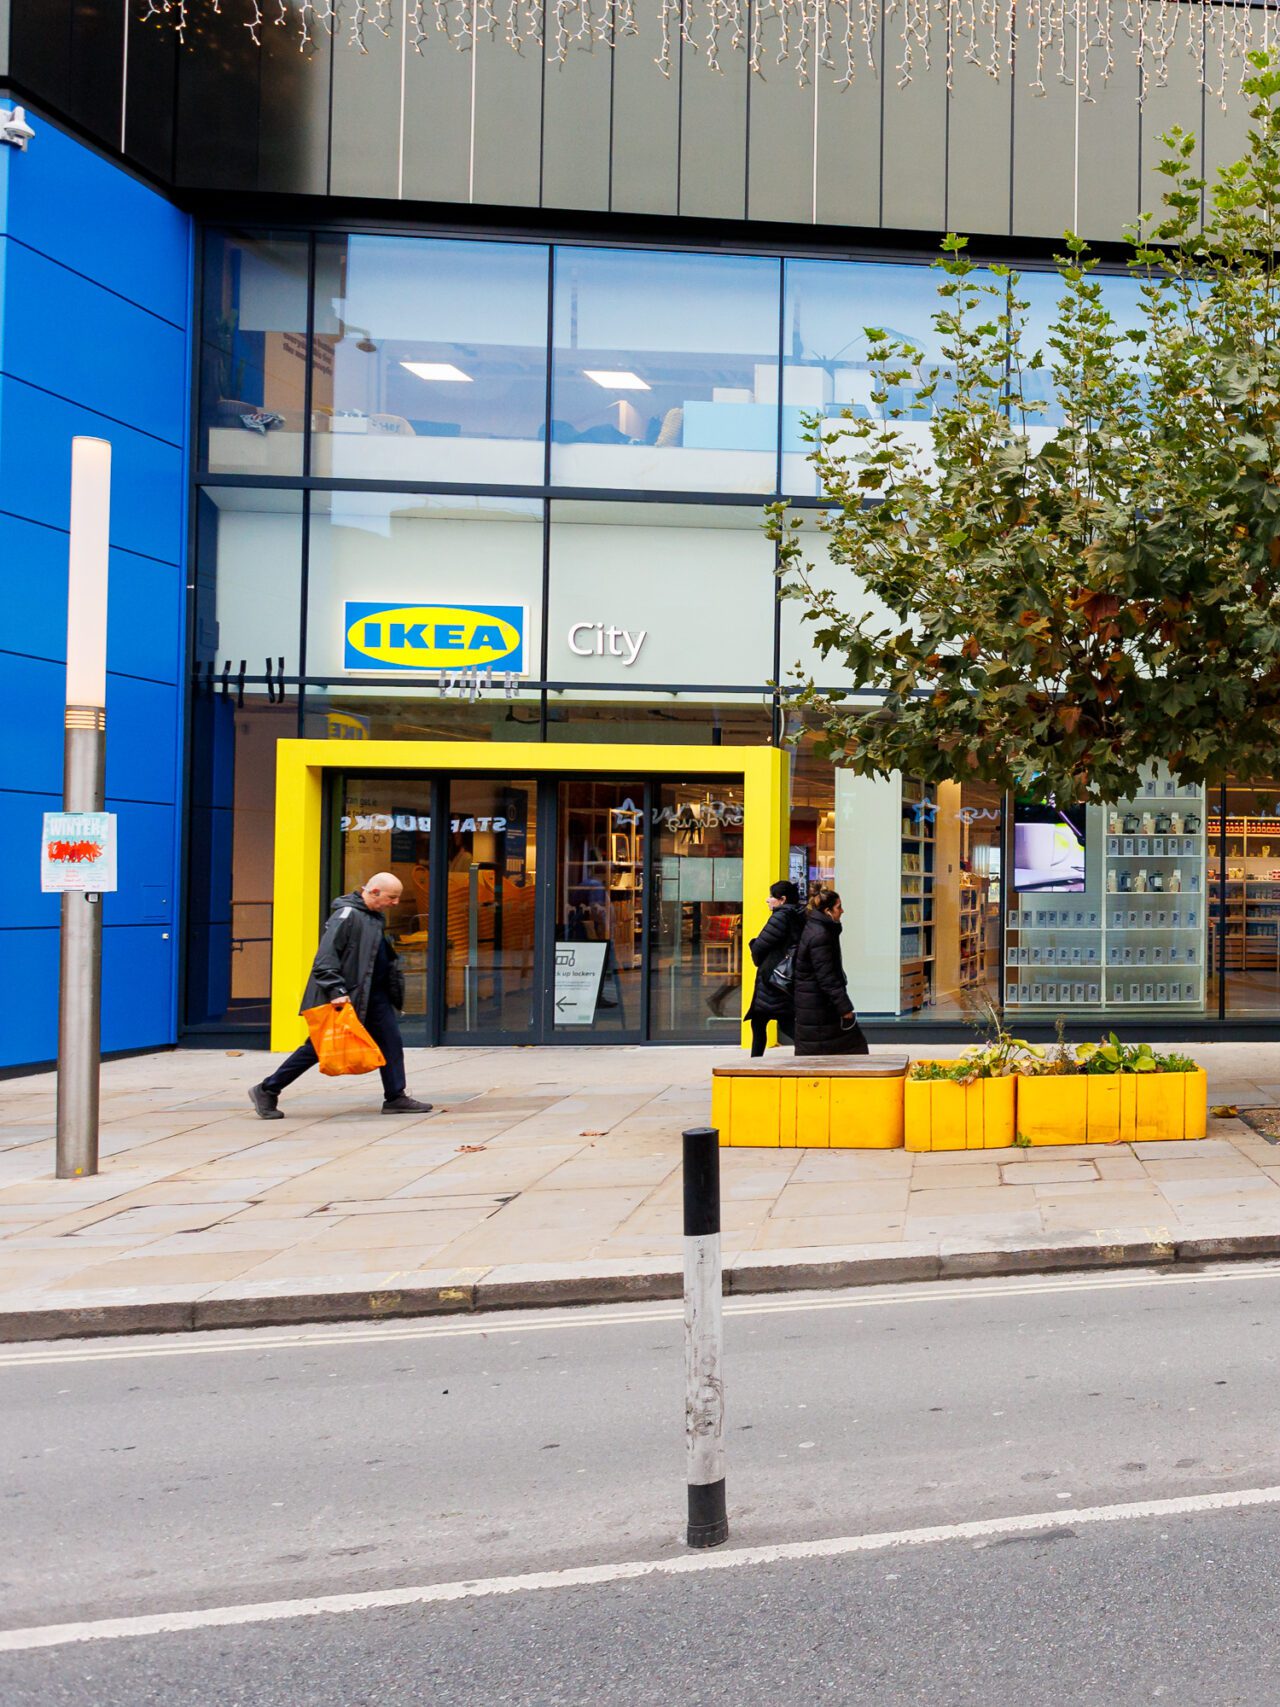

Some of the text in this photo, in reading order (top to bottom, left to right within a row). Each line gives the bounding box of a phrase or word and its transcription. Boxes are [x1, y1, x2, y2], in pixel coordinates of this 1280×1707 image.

[363, 622, 508, 650] IKEA
[567, 622, 648, 666] City
[49, 817, 102, 836] WINTER
